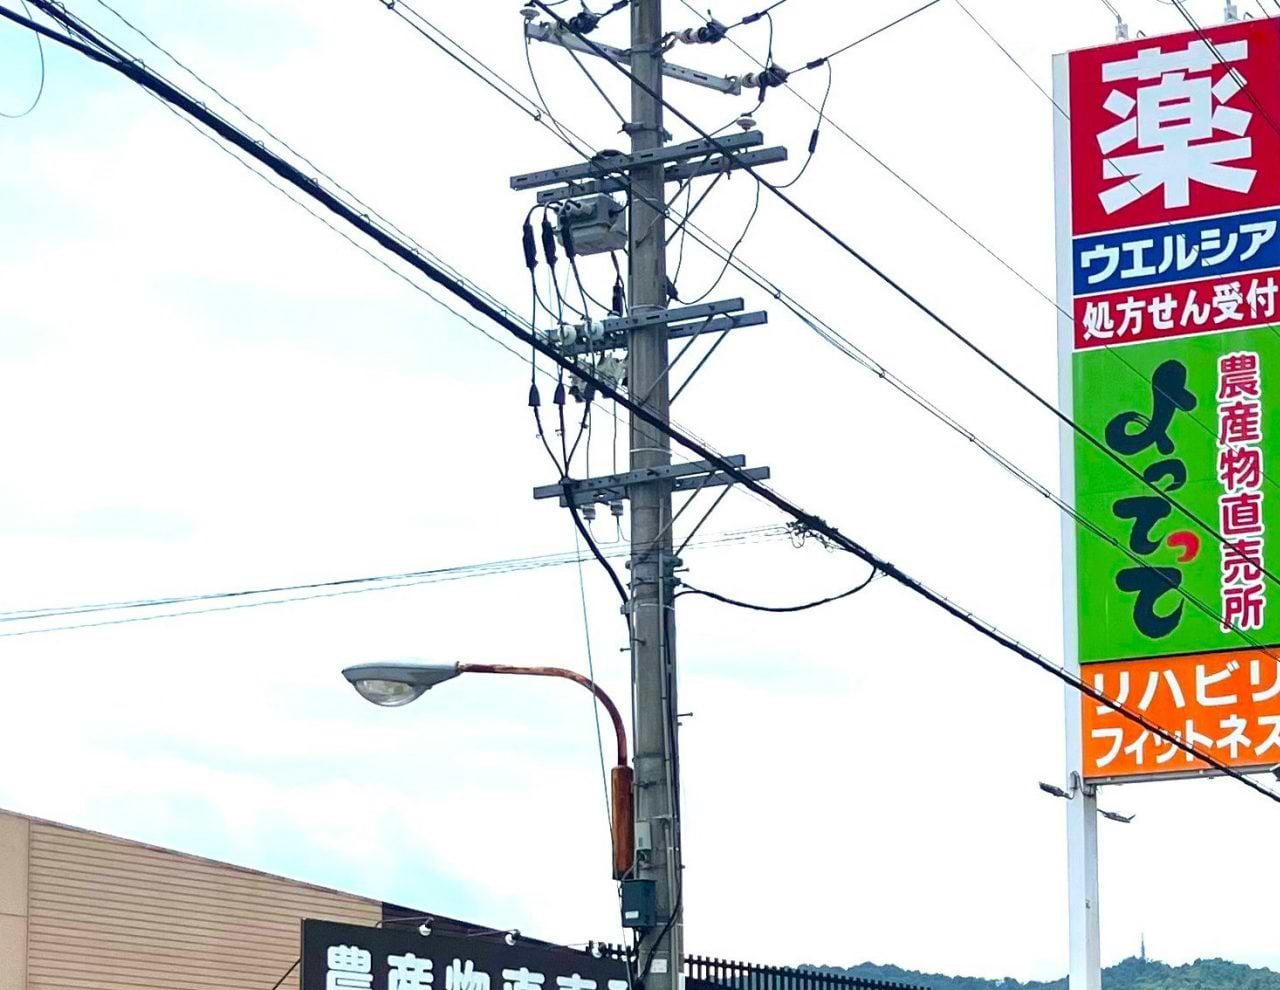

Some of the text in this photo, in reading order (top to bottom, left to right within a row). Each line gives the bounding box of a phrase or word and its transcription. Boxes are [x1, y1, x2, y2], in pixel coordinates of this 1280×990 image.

[1096, 38, 1258, 215] 薬
[1081, 220, 1278, 285] ウエルシア
[1082, 277, 1279, 341] 処方せん受付
[1104, 358, 1201, 639] よってって
[1217, 352, 1264, 632] 農産物直売所
